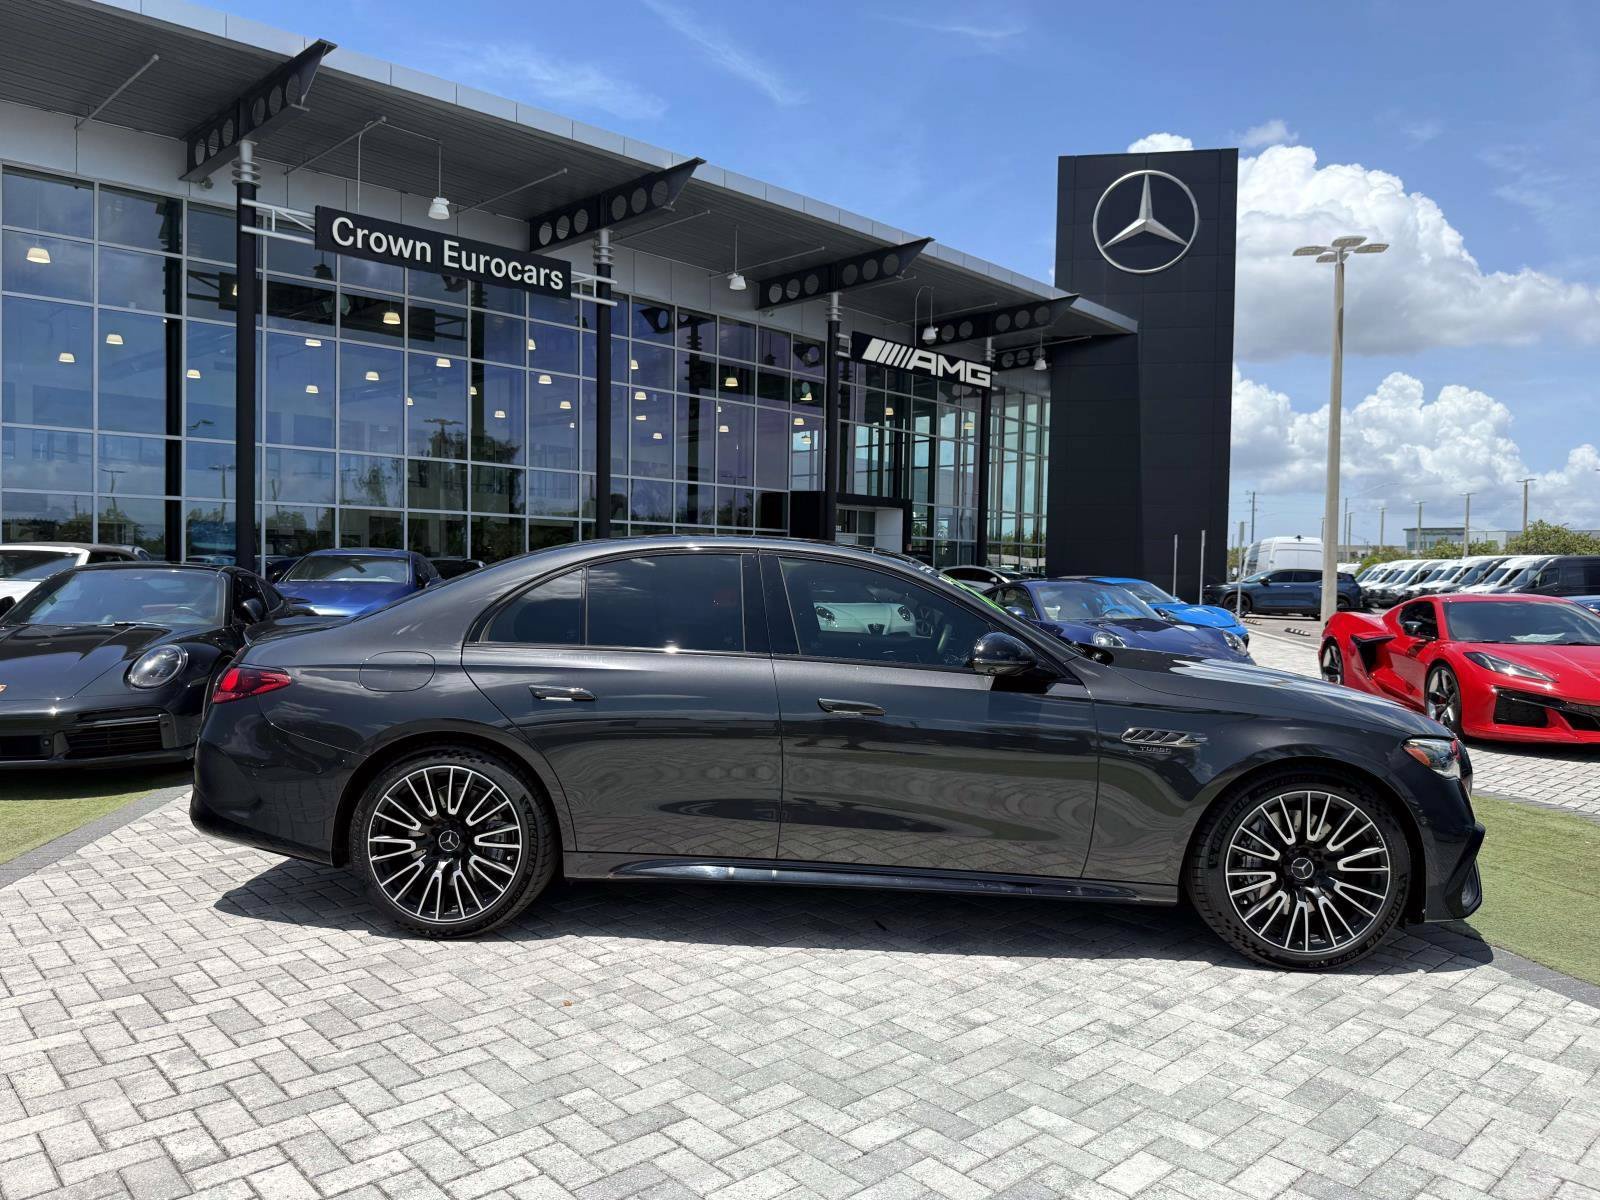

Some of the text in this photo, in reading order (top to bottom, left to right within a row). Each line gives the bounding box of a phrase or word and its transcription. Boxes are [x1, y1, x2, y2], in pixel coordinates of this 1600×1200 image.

[332, 216, 564, 290] Crown Eurocars
[905, 348, 991, 388] AMG
